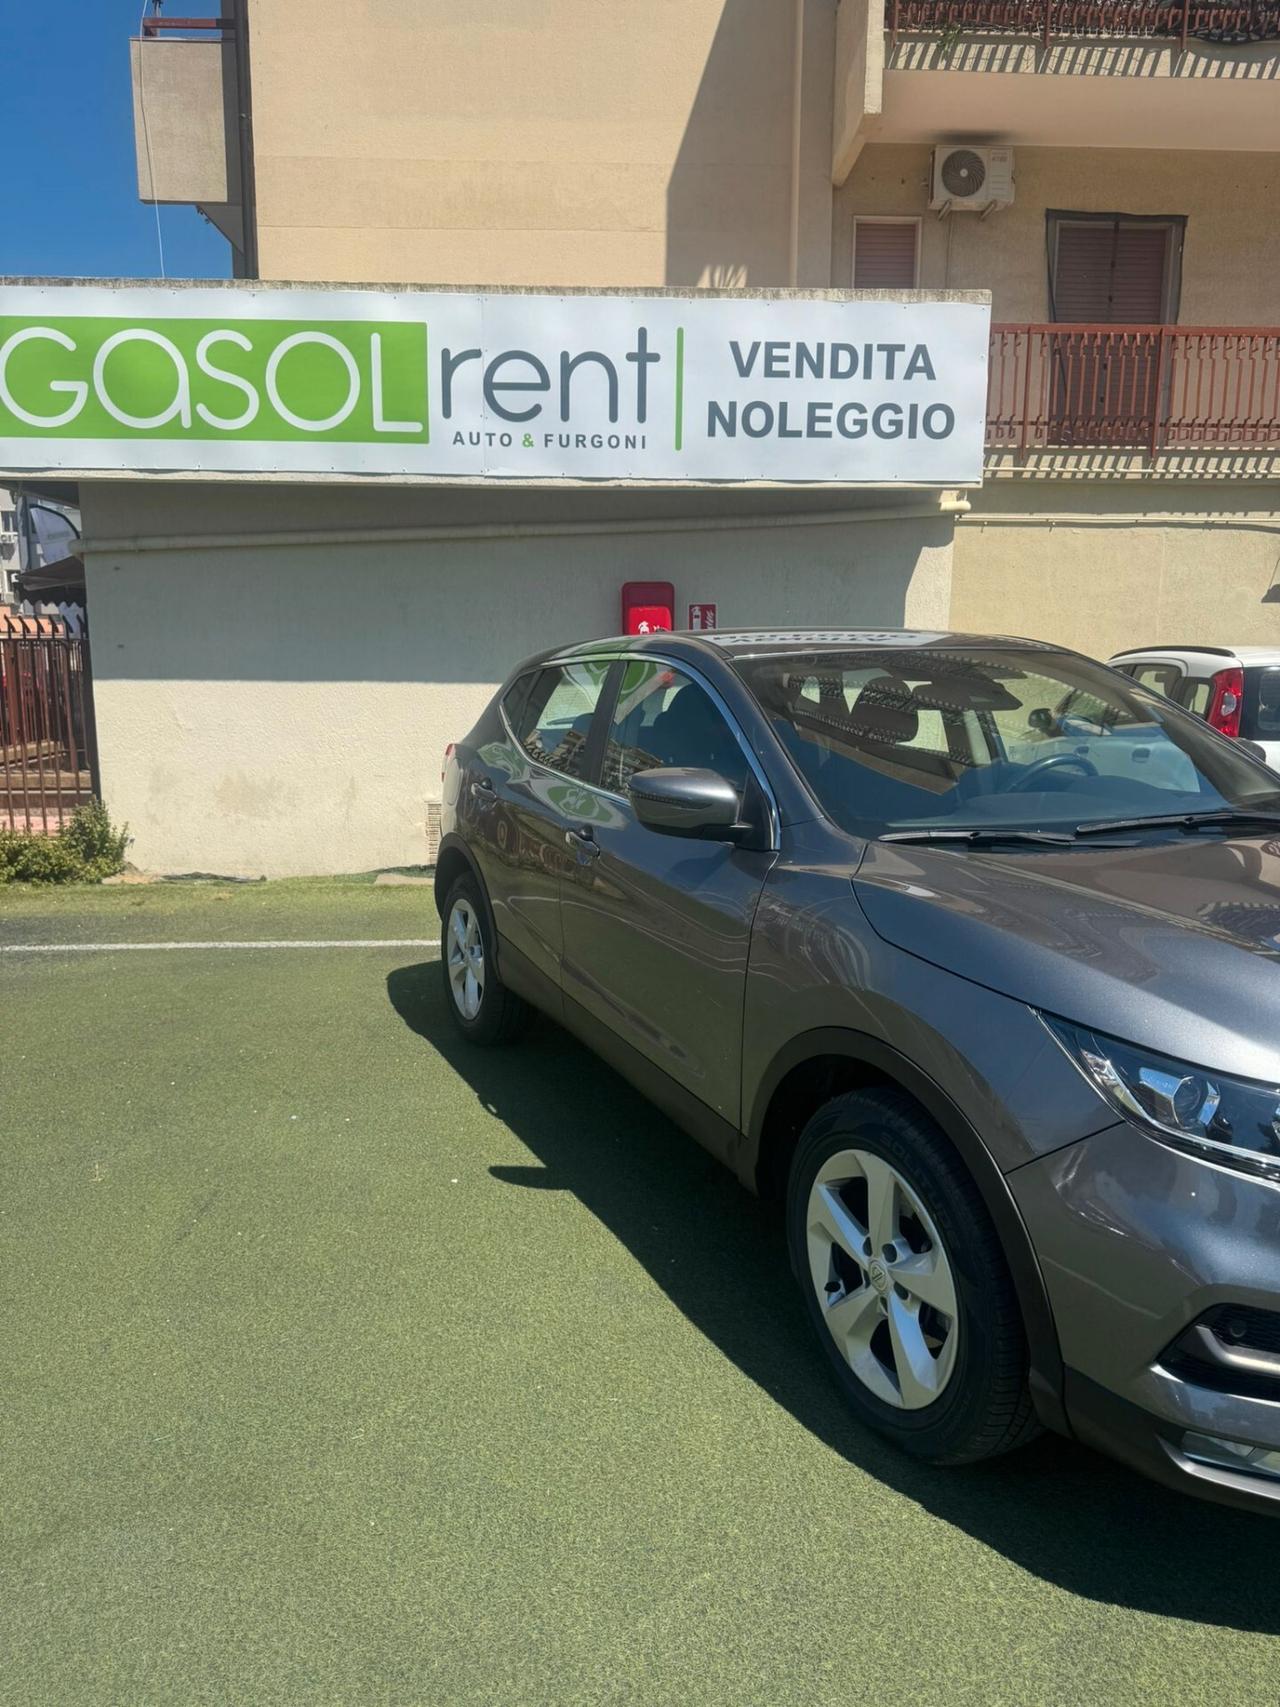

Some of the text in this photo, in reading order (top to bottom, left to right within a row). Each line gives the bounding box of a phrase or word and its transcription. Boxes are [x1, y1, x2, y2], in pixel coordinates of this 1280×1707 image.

[441, 326, 661, 424] rent
[728, 340, 937, 380] VENDITA
[706, 400, 956, 440] NOLEGGIO
[452, 431, 647, 450] AUTO & FURGONI
